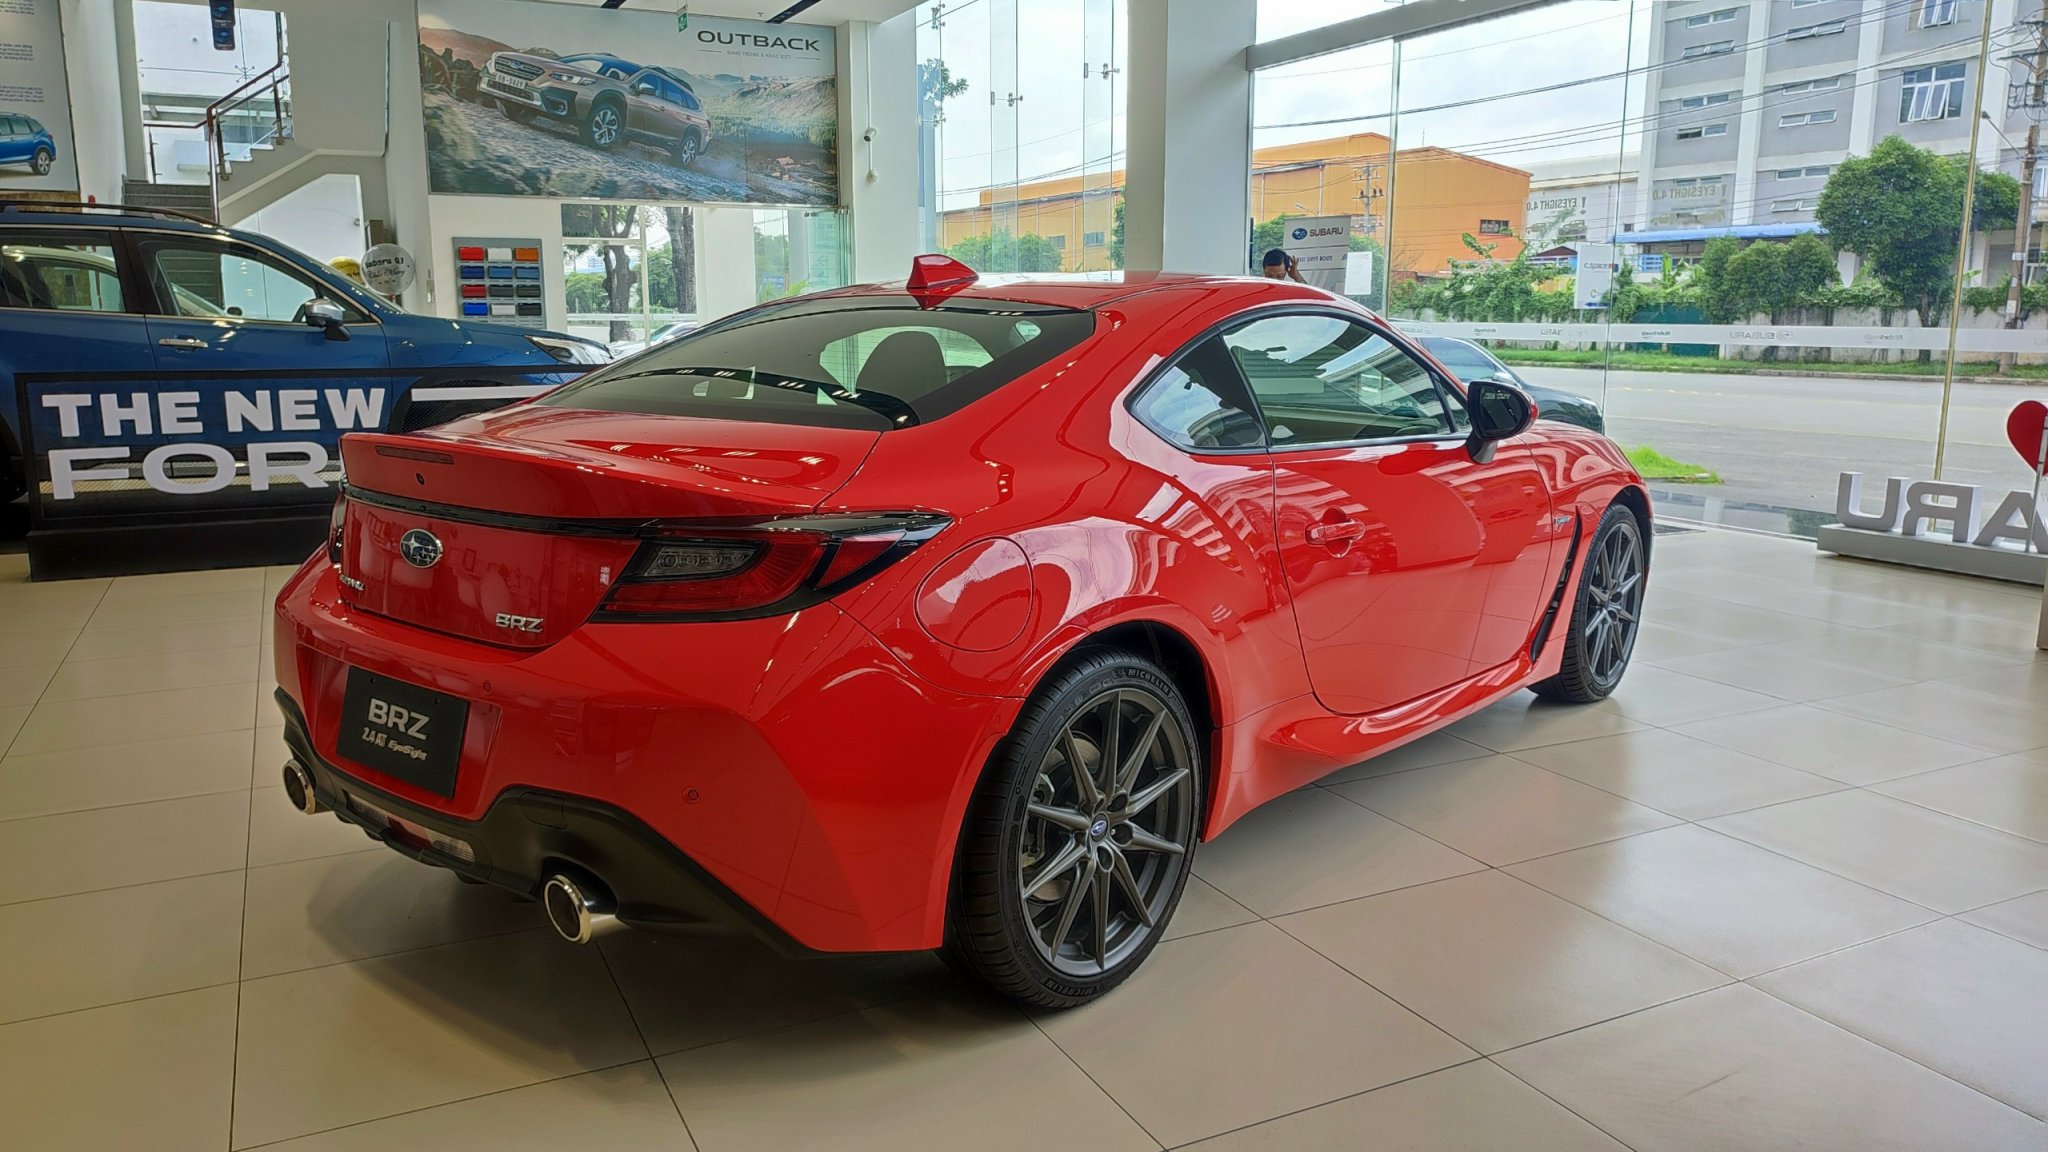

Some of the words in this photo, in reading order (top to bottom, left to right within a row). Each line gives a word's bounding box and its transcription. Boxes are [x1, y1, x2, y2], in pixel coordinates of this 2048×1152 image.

[697, 30, 821, 52] OUTBACK
[1310, 227, 1344, 237] SUBARU
[42, 391, 203, 437] THE
[224, 388, 385, 432] NEW
[495, 612, 544, 633] BRZ
[1128, 668, 1172, 696] MICHELIN
[367, 698, 430, 741] BRZ
[1045, 978, 1098, 996] MICHELIN
